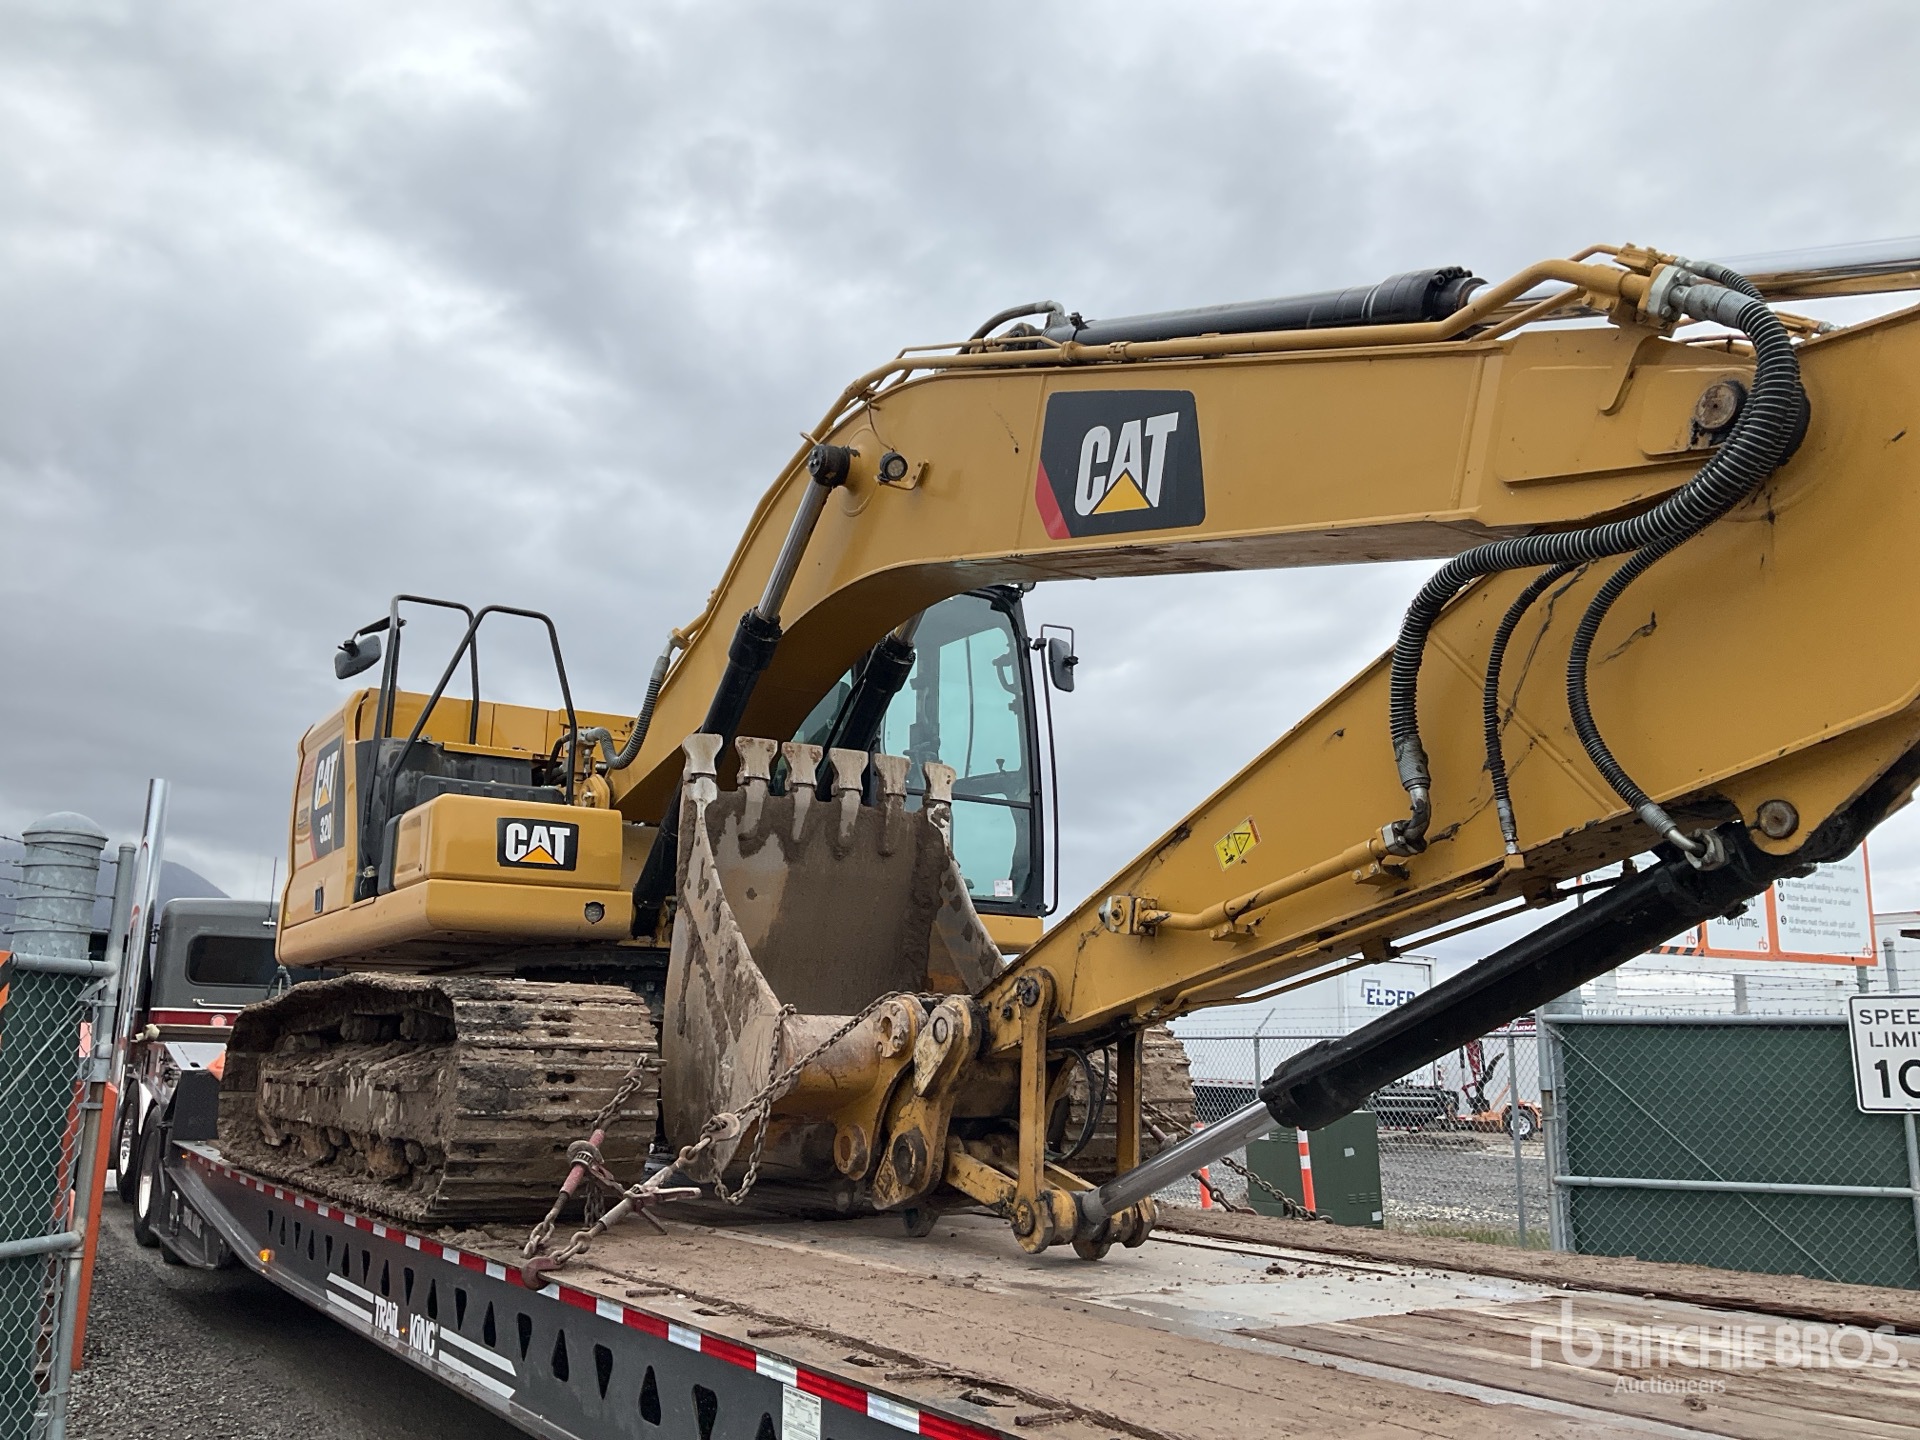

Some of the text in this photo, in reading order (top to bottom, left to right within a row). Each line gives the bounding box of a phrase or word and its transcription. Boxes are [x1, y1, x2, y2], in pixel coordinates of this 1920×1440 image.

[1075, 412, 1179, 516] CAT
[314, 750, 339, 811] CAT
[320, 812, 332, 844] 320
[505, 823, 570, 866] CAT
[1859, 1009, 1920, 1025] SPEE
[1869, 1031, 1920, 1048] LIMI
[1874, 1059, 1920, 1099] 10
